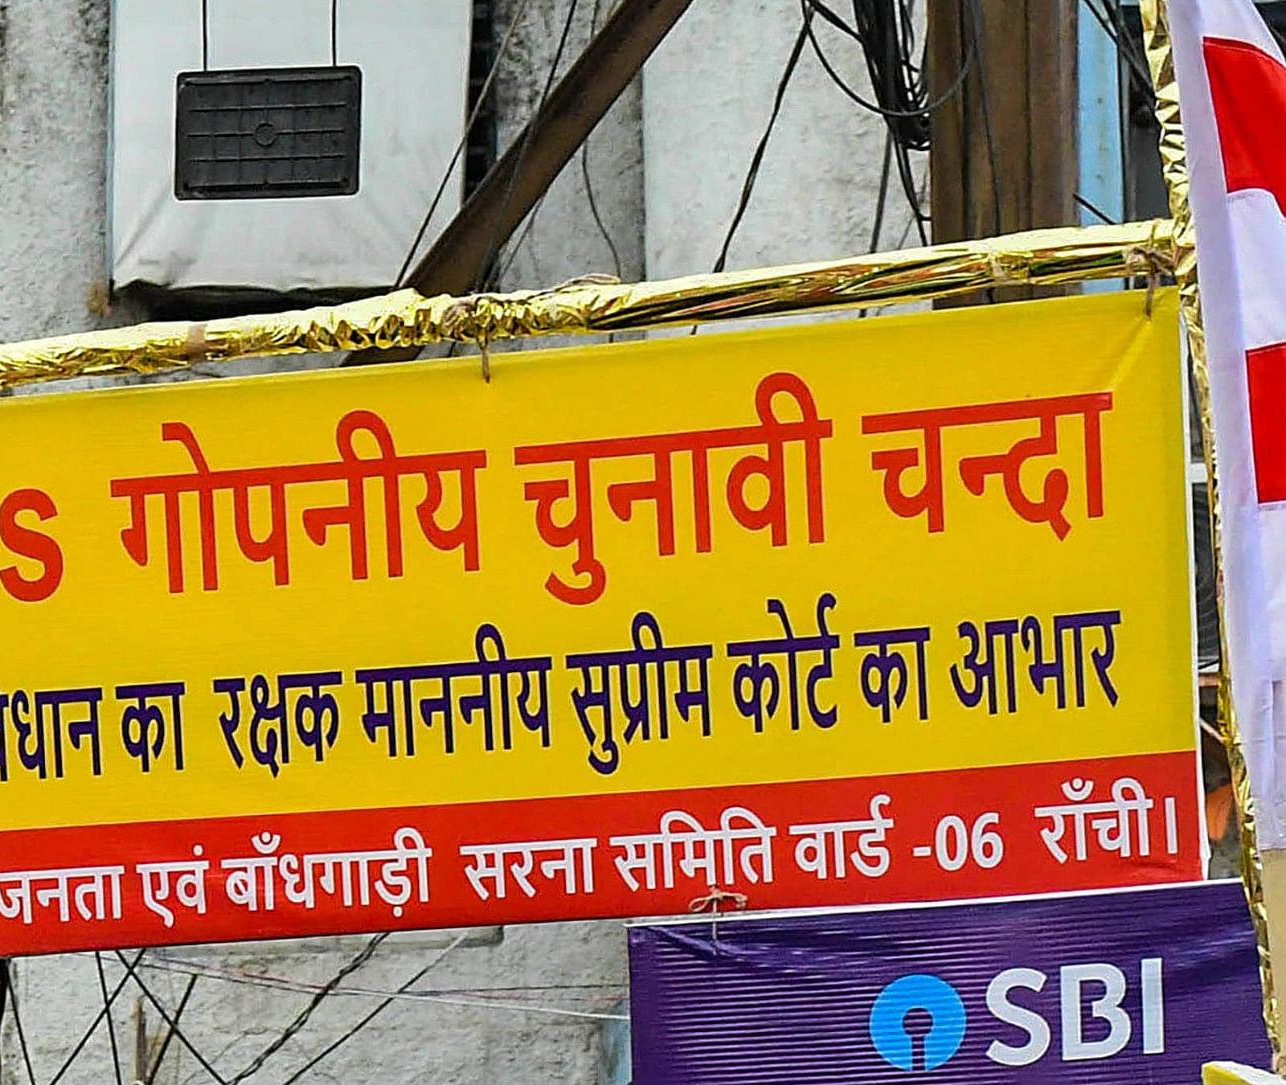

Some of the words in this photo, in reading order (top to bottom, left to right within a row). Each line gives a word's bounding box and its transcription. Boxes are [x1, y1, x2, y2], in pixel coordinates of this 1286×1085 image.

[110, 409, 487, 594] गोपनीय
[514, 371, 833, 606] चुनावी
[861, 391, 1114, 541] चन्दा
[114, 681, 186, 774] का
[212, 671, 344, 779] रक्षक
[354, 623, 554, 759] माननीय
[565, 611, 714, 776] सुप्रीम
[726, 592, 841, 734] कोर्ट
[853, 626, 931, 725] का
[949, 610, 1122, 716] आभार
[135, 843, 210, 928] एवं
[220, 827, 433, 917] बाँधगाड़ी
[459, 837, 598, 901] सरना
[609, 806, 777, 888] समिति
[789, 794, 894, 881] वार्ड
[912, 812, 1004, 872] -06
[984, 957, 1166, 1066] SBI
